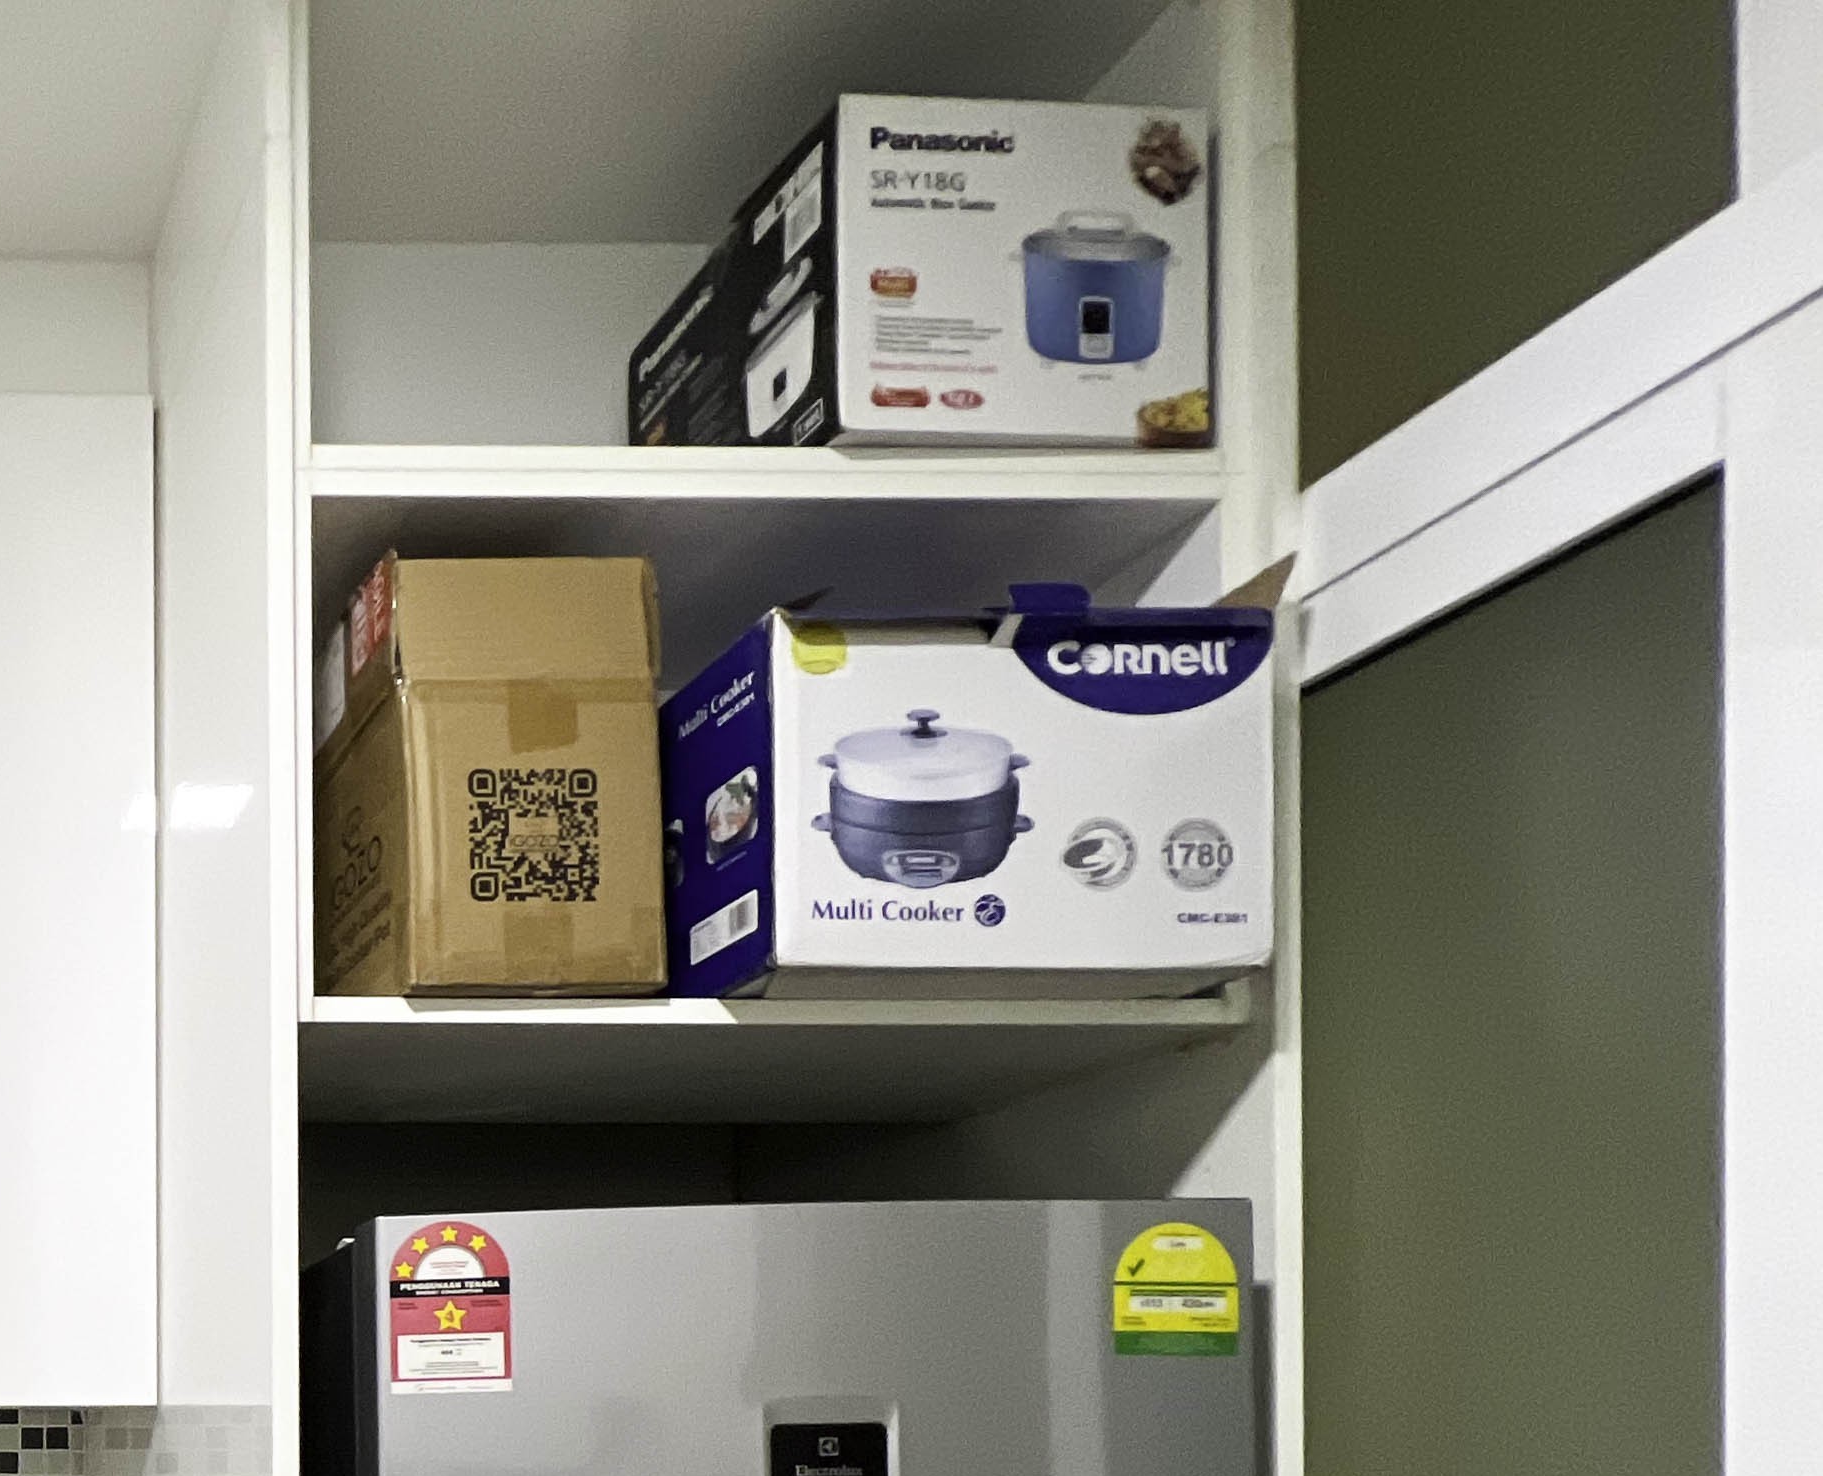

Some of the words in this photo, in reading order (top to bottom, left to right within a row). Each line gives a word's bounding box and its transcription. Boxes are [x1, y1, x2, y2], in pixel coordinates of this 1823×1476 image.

[870, 126, 1014, 153] Panasonic
[1161, 842, 1234, 868] 1780
[811, 899, 873, 922] Multi
[881, 899, 965, 923] Cooker
